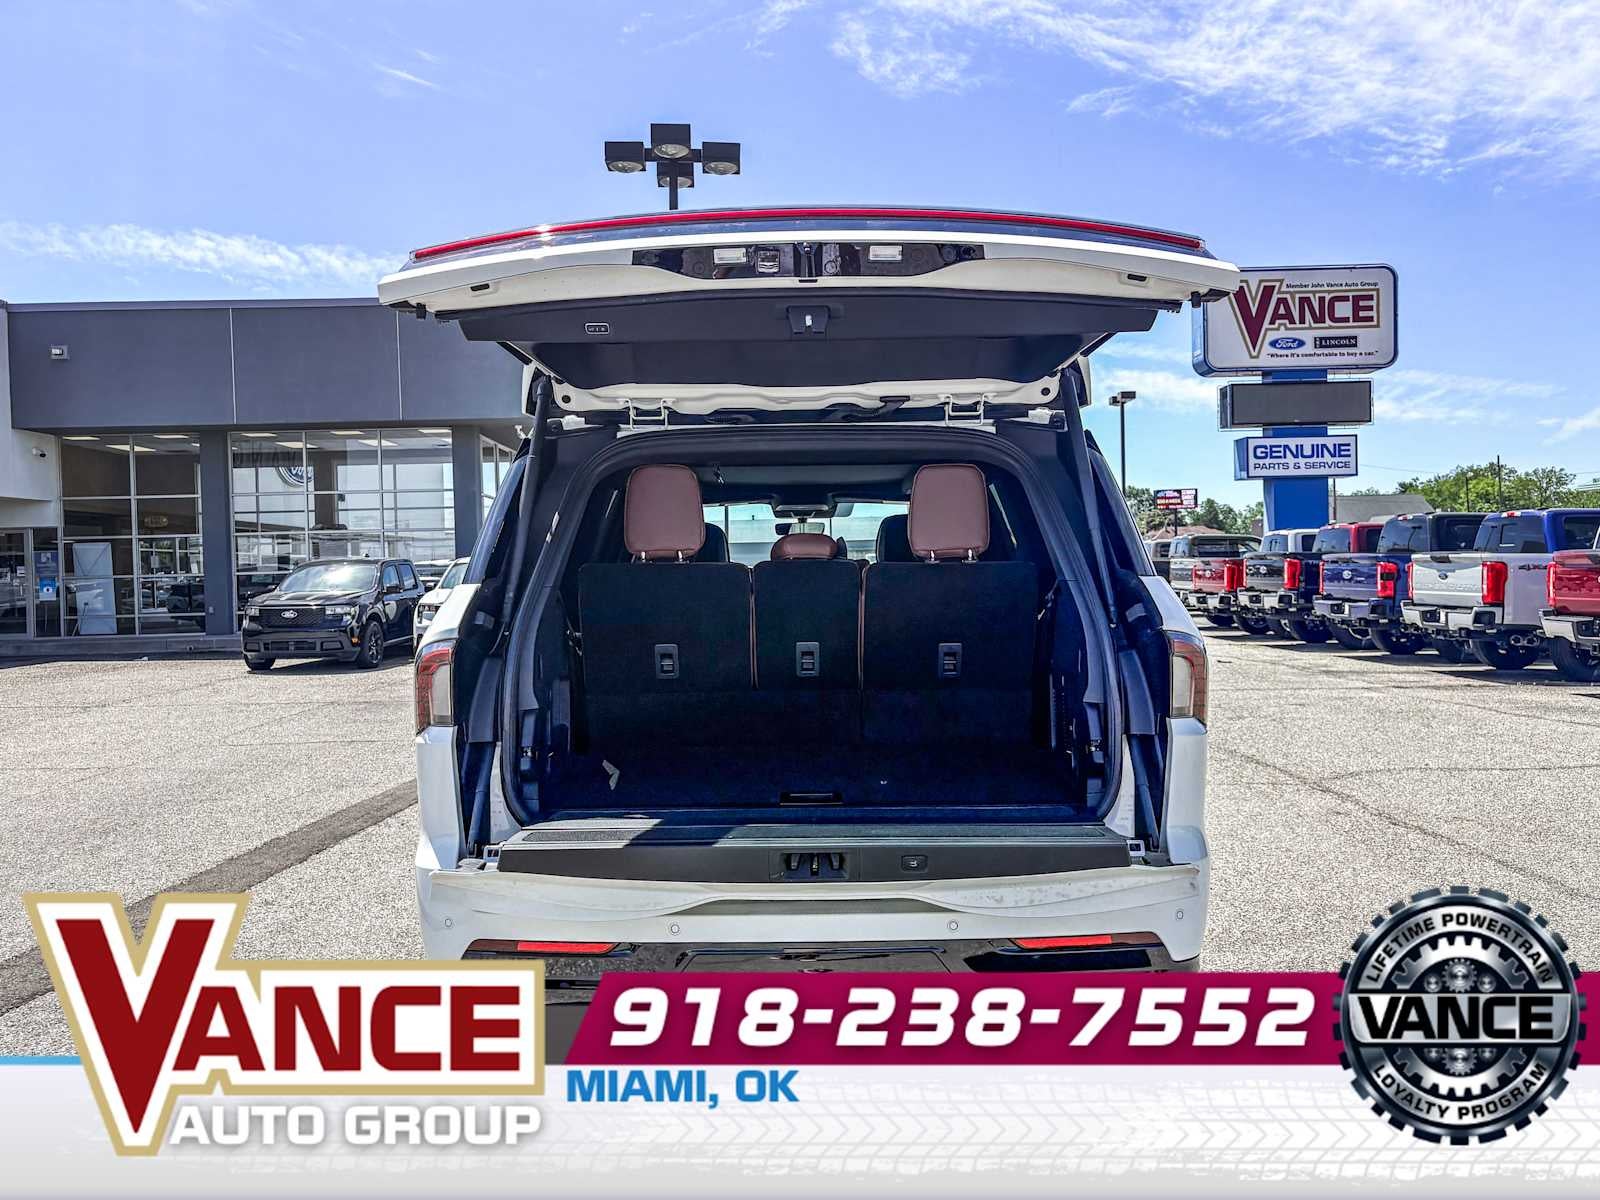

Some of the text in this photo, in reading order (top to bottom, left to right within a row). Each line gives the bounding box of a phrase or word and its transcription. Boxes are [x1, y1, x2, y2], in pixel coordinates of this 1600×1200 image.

[1360, 280, 1379, 288] Group
[1232, 285, 1374, 353] VANCE
[1275, 338, 1299, 349] Ford
[1321, 338, 1356, 346] LINCOLN
[1253, 443, 1352, 460] GENUINE
[1253, 460, 1351, 471] PARTS & SERVICE
